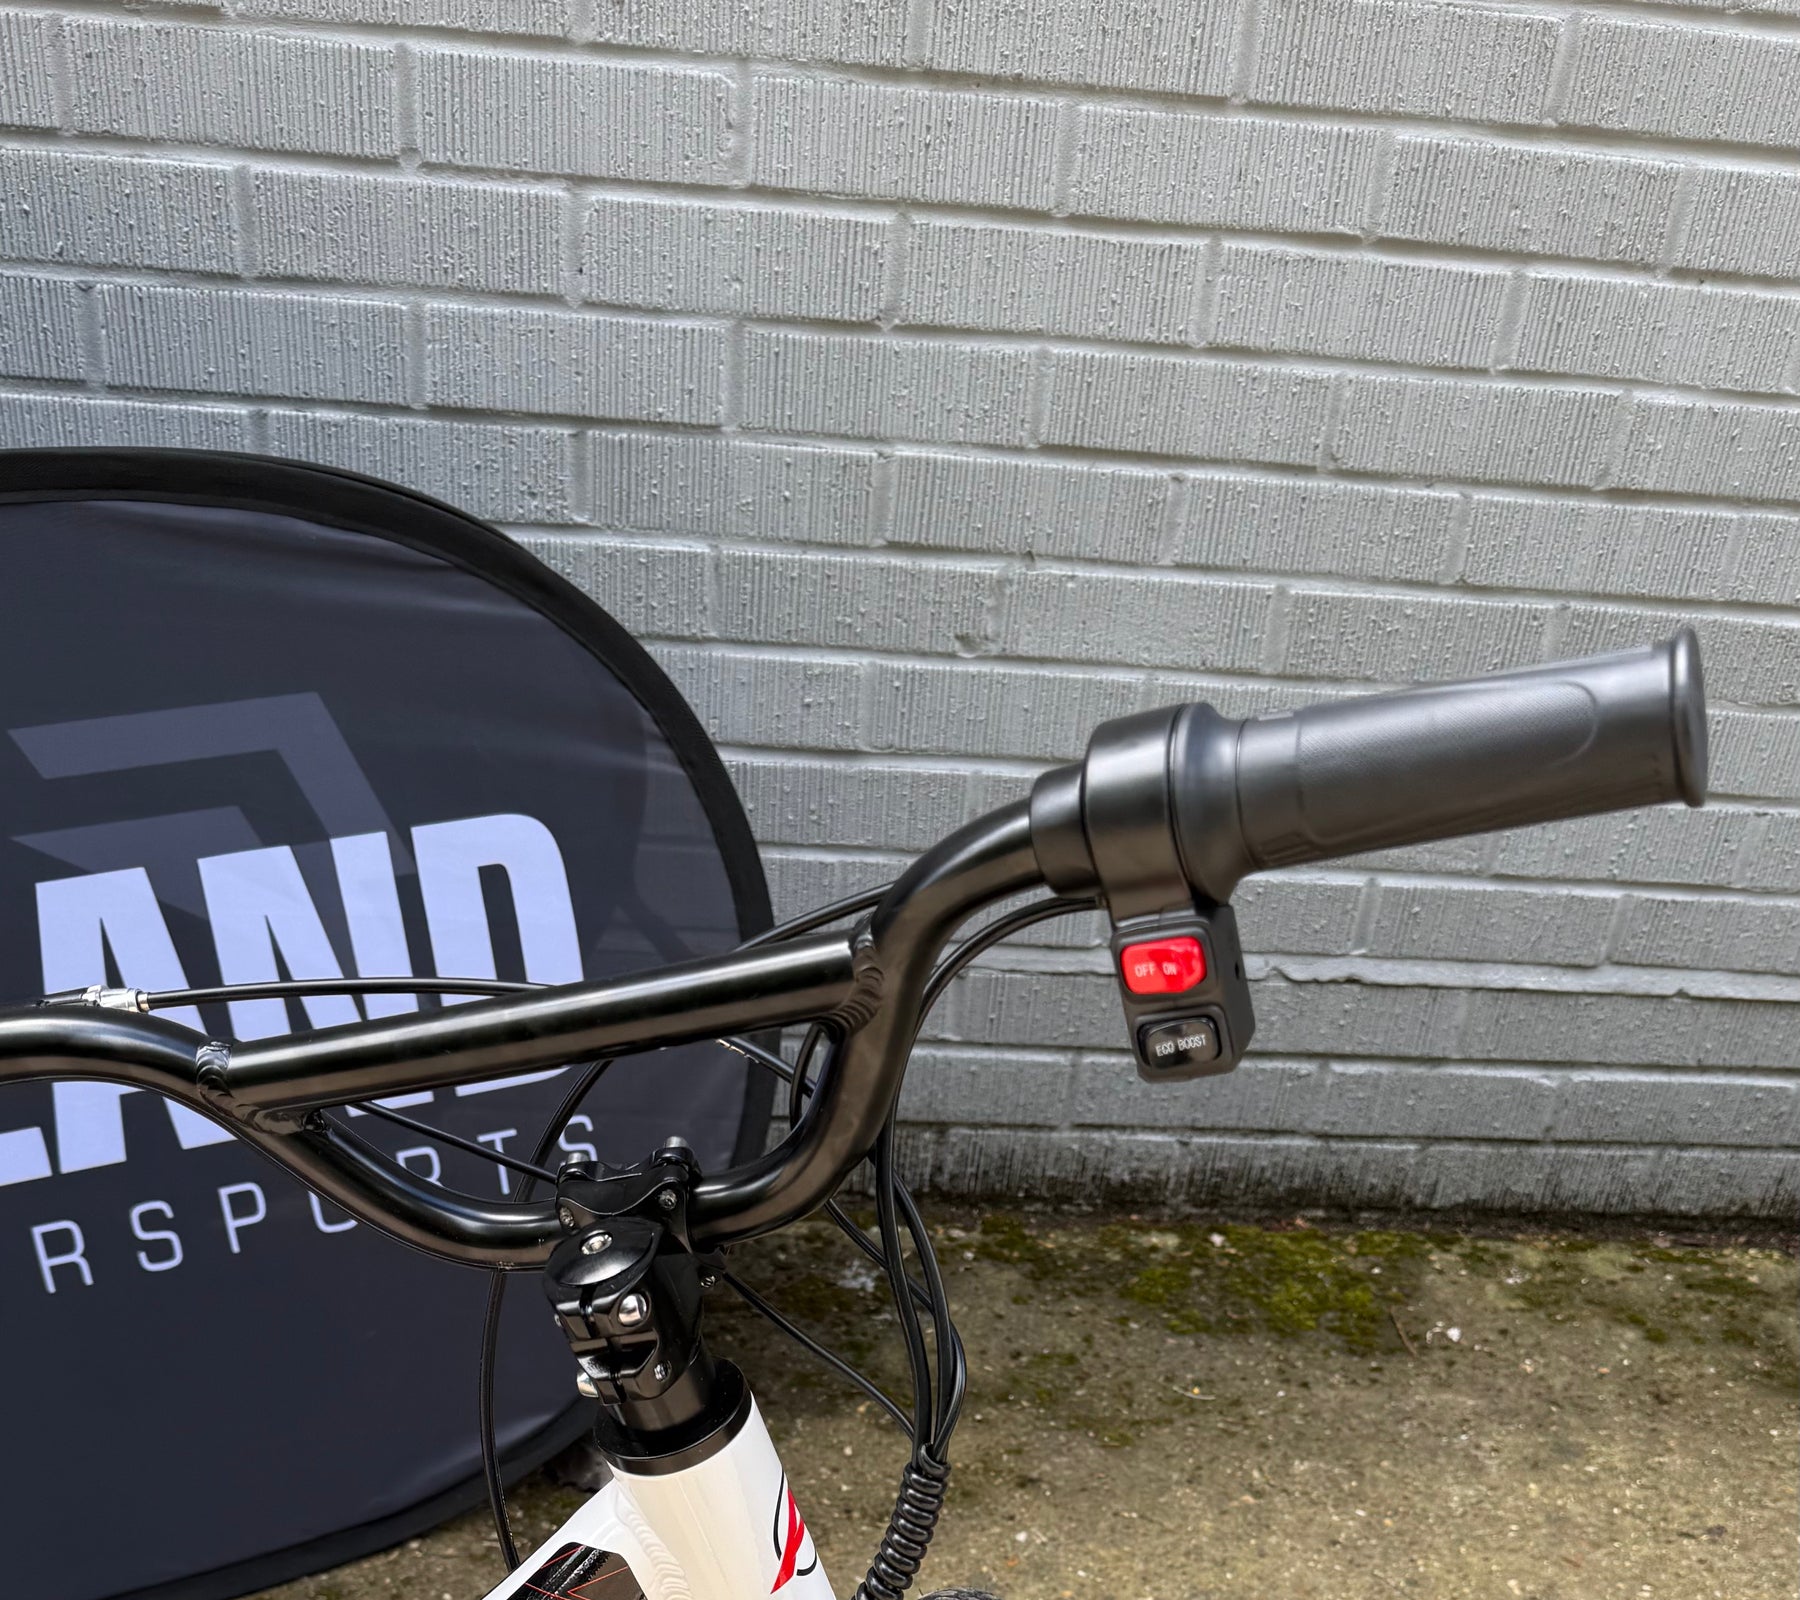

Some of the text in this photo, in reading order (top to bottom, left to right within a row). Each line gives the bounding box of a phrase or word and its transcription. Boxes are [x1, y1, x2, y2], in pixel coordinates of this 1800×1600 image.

[1134, 962, 1178, 977] OFF ON
[0, 813, 585, 1186] AND
[1155, 1034, 1206, 1057] ECO BOOST
